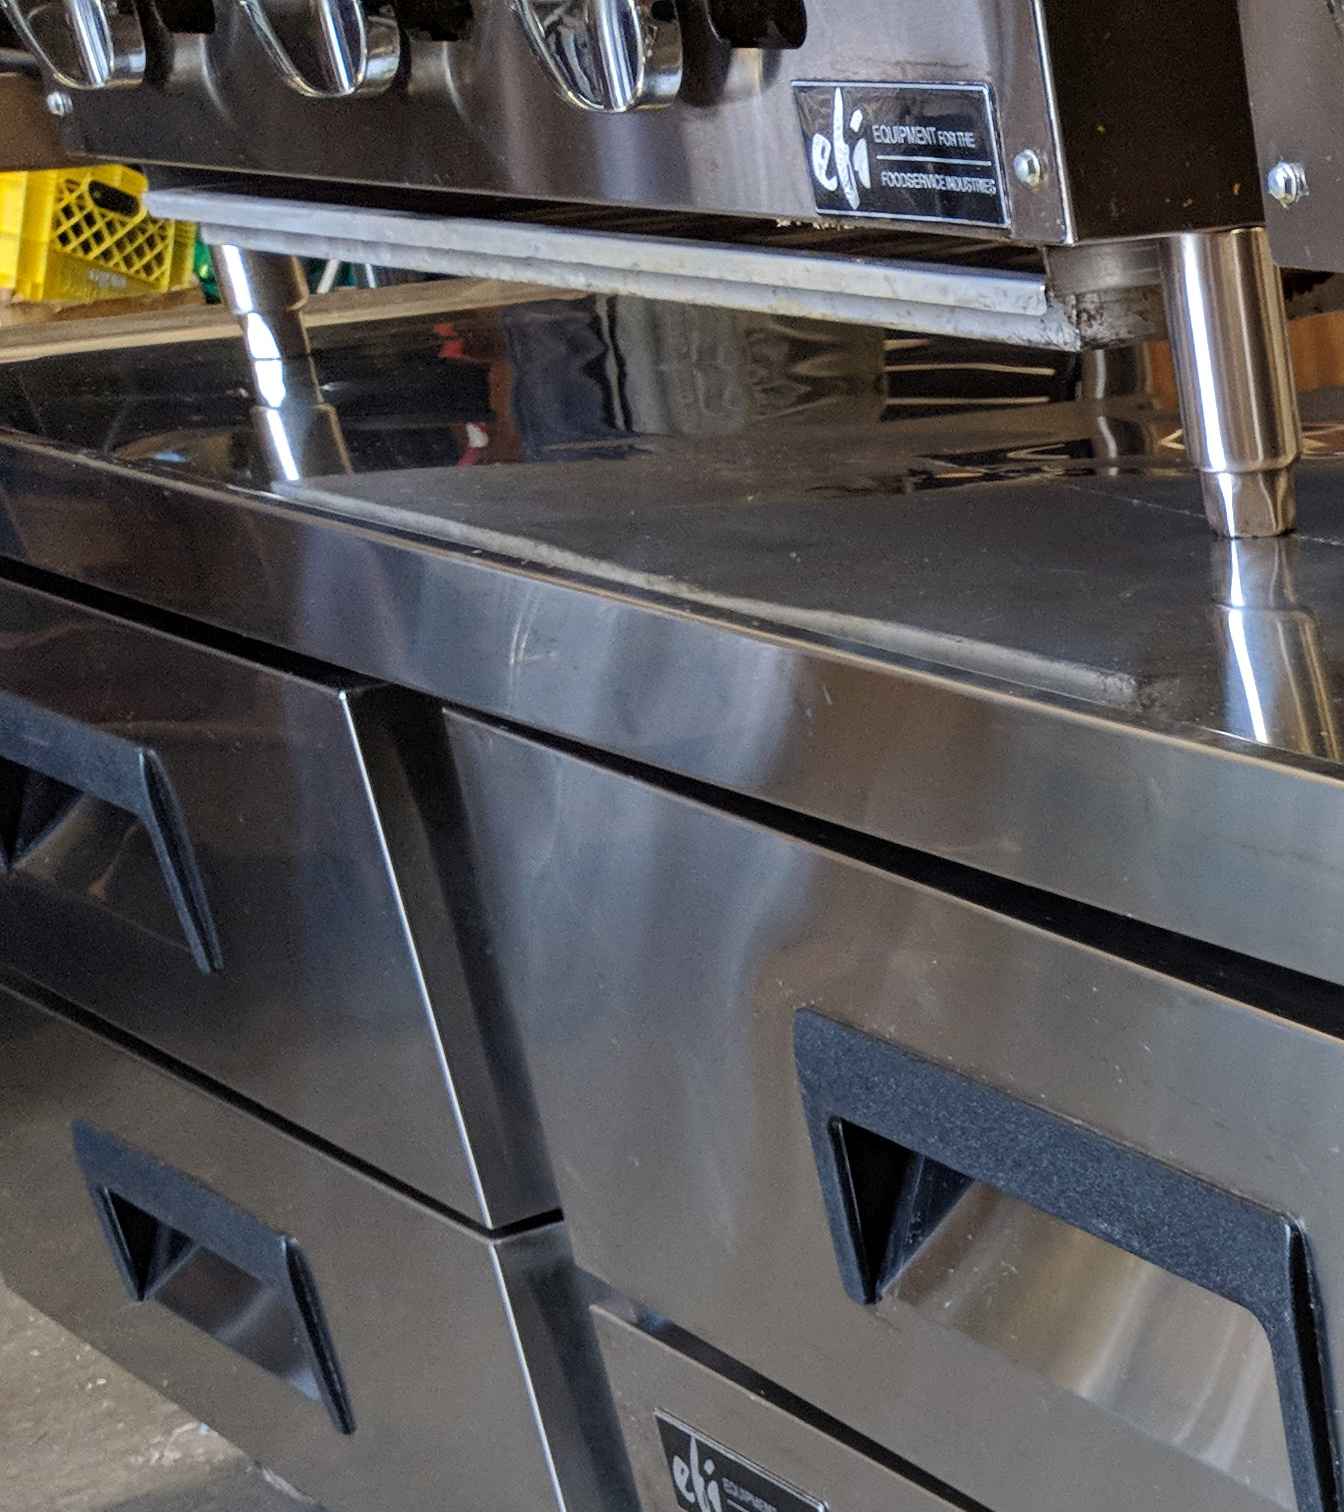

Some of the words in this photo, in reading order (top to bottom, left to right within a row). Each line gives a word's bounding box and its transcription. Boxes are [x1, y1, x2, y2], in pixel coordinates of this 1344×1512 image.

[812, 87, 872, 210] efi
[872, 125, 937, 145] EQUIPMENT
[937, 131, 958, 147] FOR
[956, 132, 976, 149] THE
[880, 171, 947, 190] FOODSERVICE
[945, 176, 997, 196] INDUSTRIES
